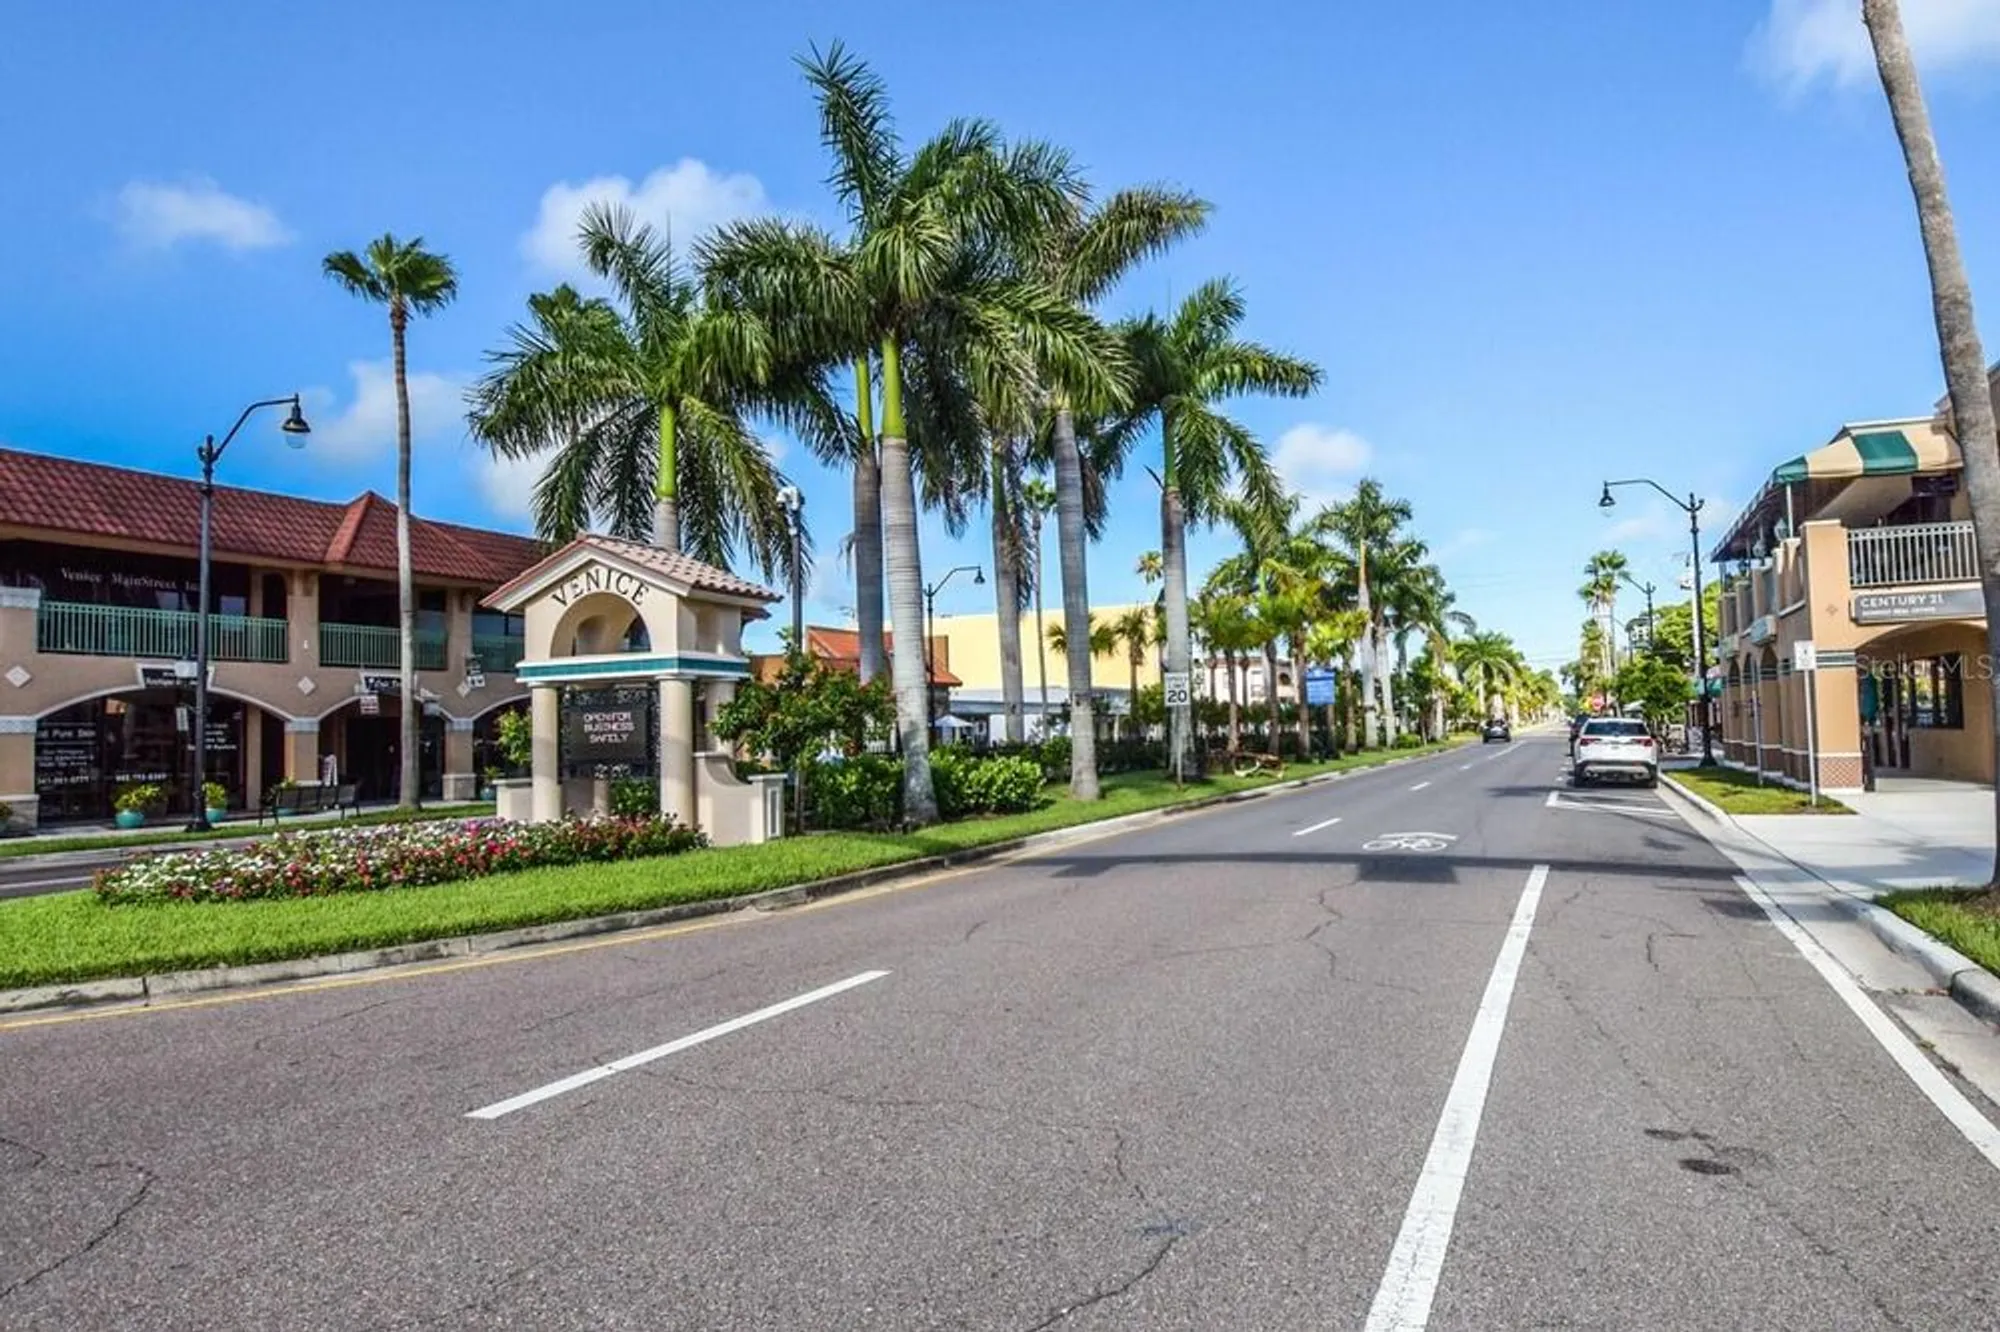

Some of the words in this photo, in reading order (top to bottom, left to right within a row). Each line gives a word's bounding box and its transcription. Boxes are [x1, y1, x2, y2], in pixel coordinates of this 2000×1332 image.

[60, 567, 102, 583] Venice
[552, 568, 649, 606] VENICE
[1860, 594, 1926, 608] CENTURY
[1929, 593, 1944, 605] 21
[1167, 690, 1188, 703] 20
